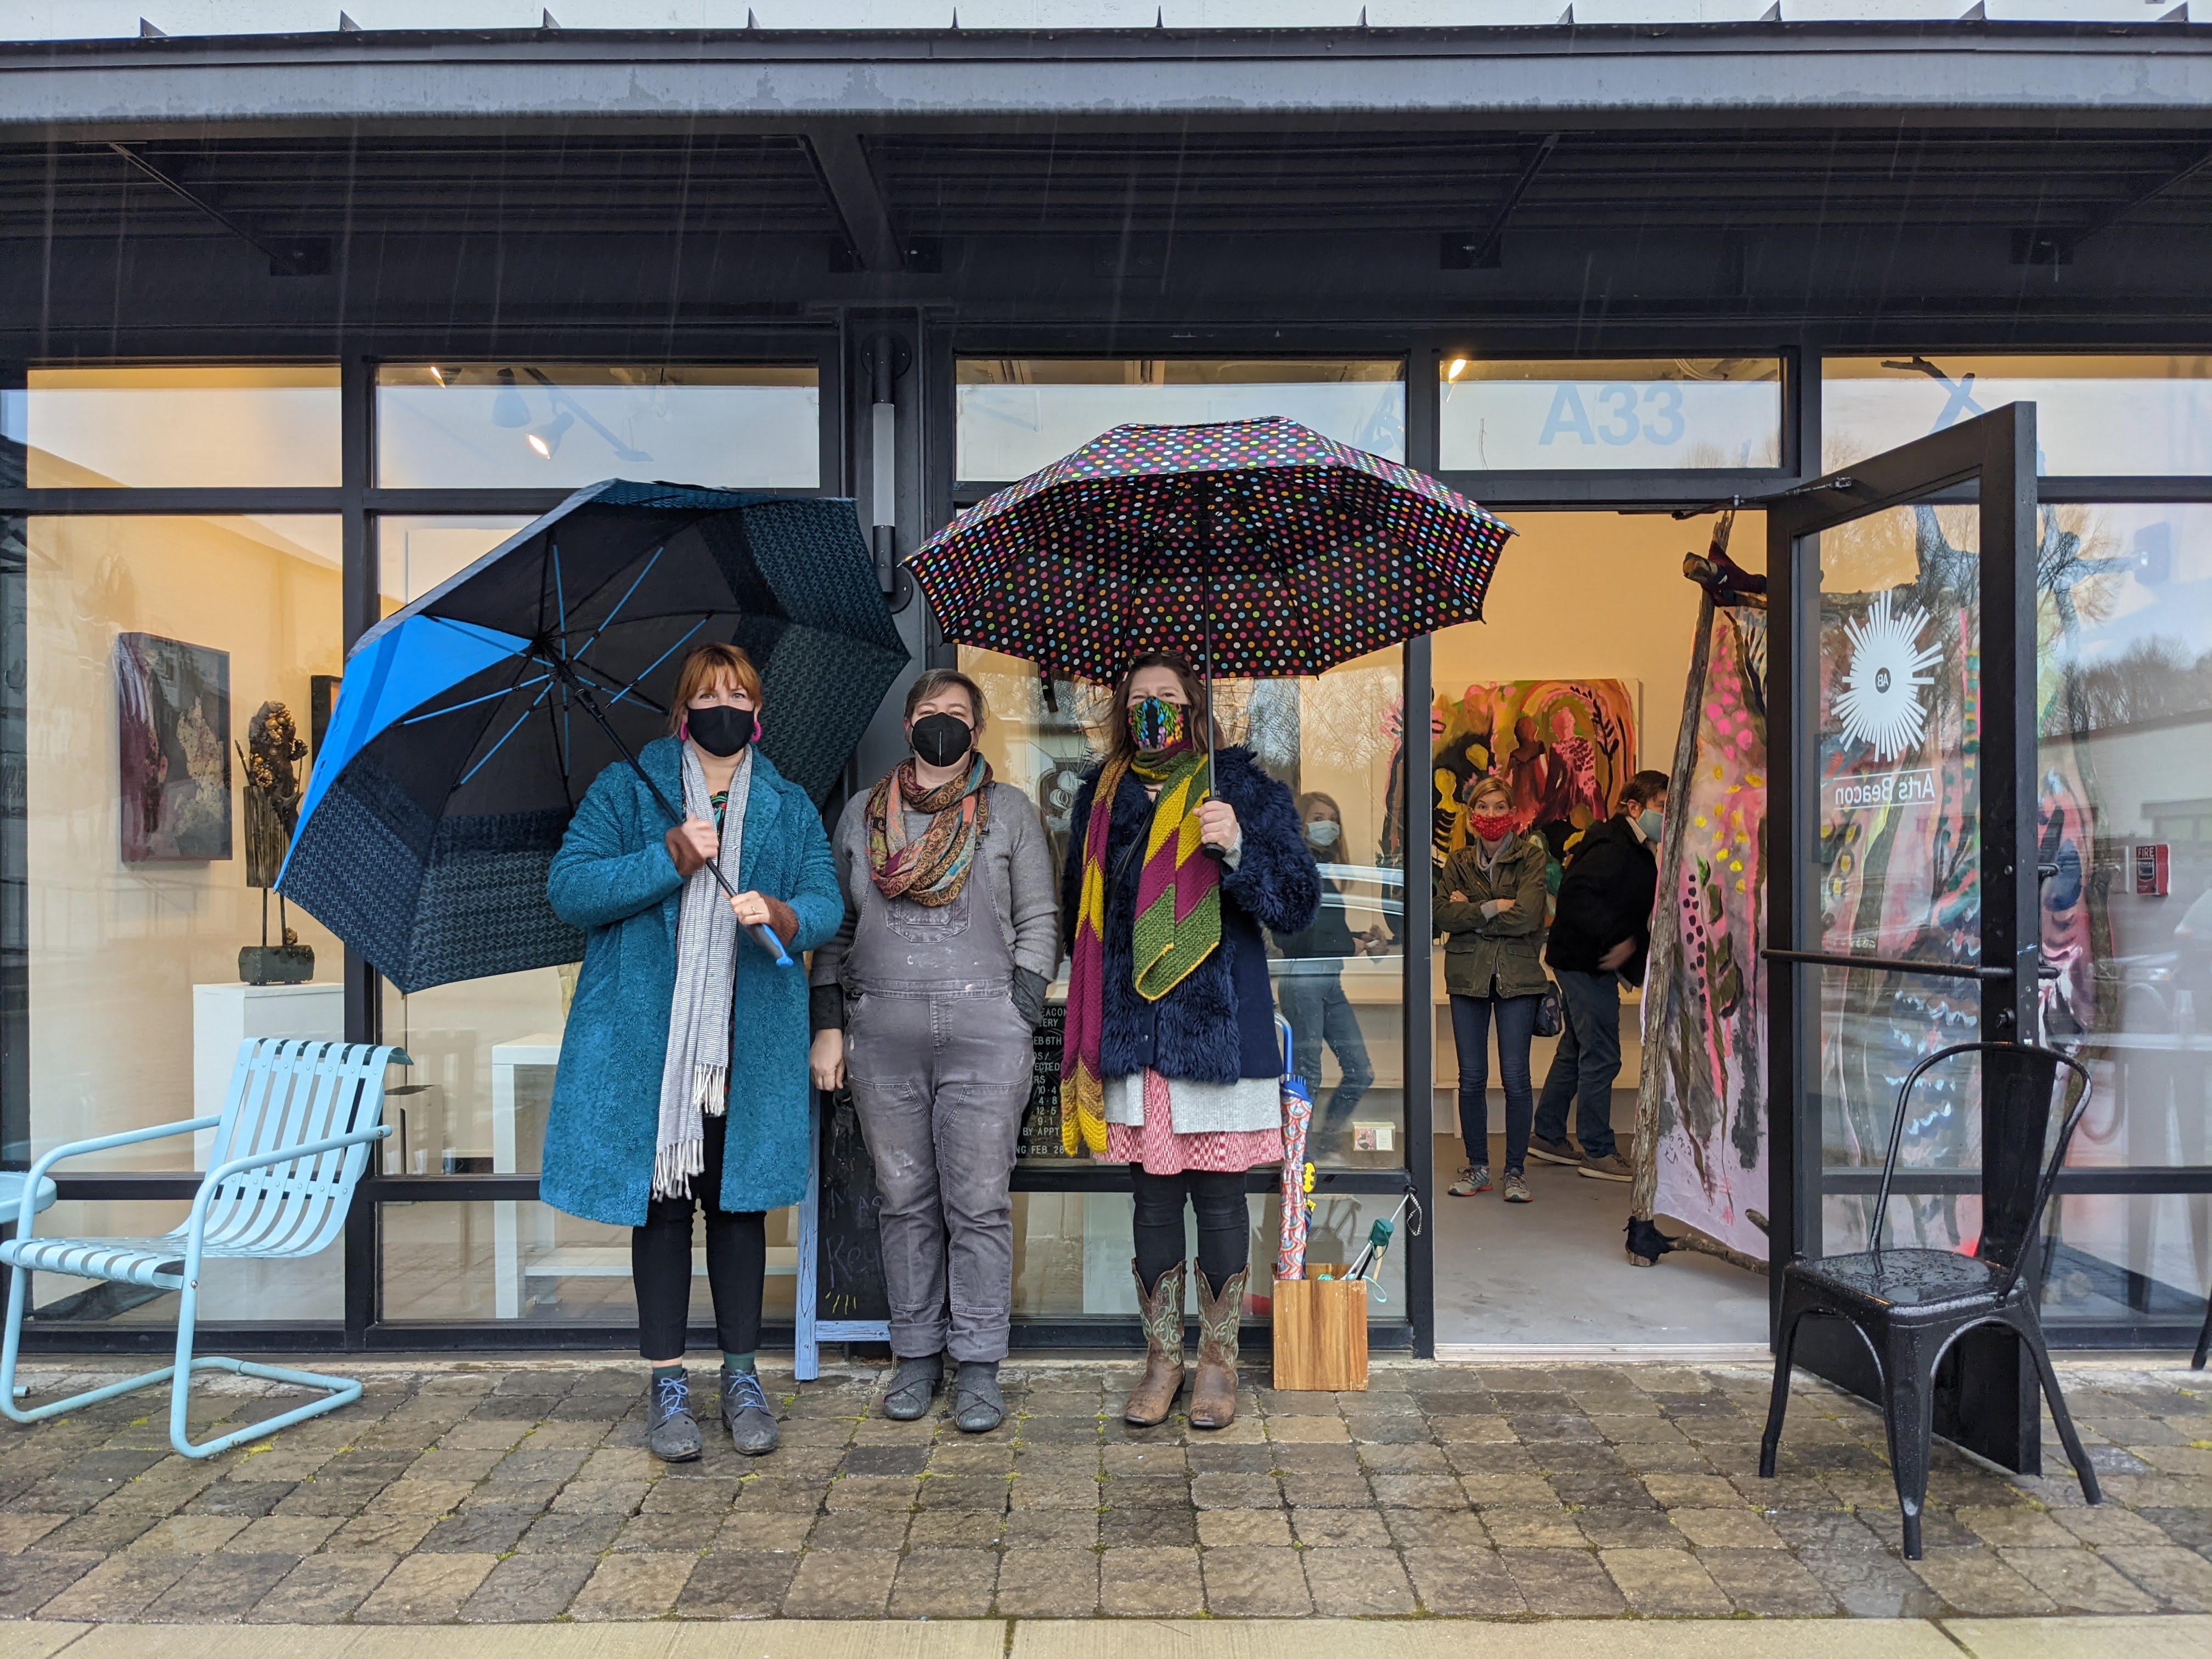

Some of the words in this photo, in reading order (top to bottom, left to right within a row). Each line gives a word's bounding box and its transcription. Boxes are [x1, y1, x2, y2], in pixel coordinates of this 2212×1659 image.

[1538, 382, 1685, 446] A33
[2138, 847, 2154, 858] FIRE
[1040, 1018, 1058, 1027] ERY
[1046, 1036, 1062, 1045] 6TH
[1023, 1127, 1033, 1136] BY
[1037, 1127, 1060, 1136] APPT
[1031, 1145, 1047, 1154] FEB
